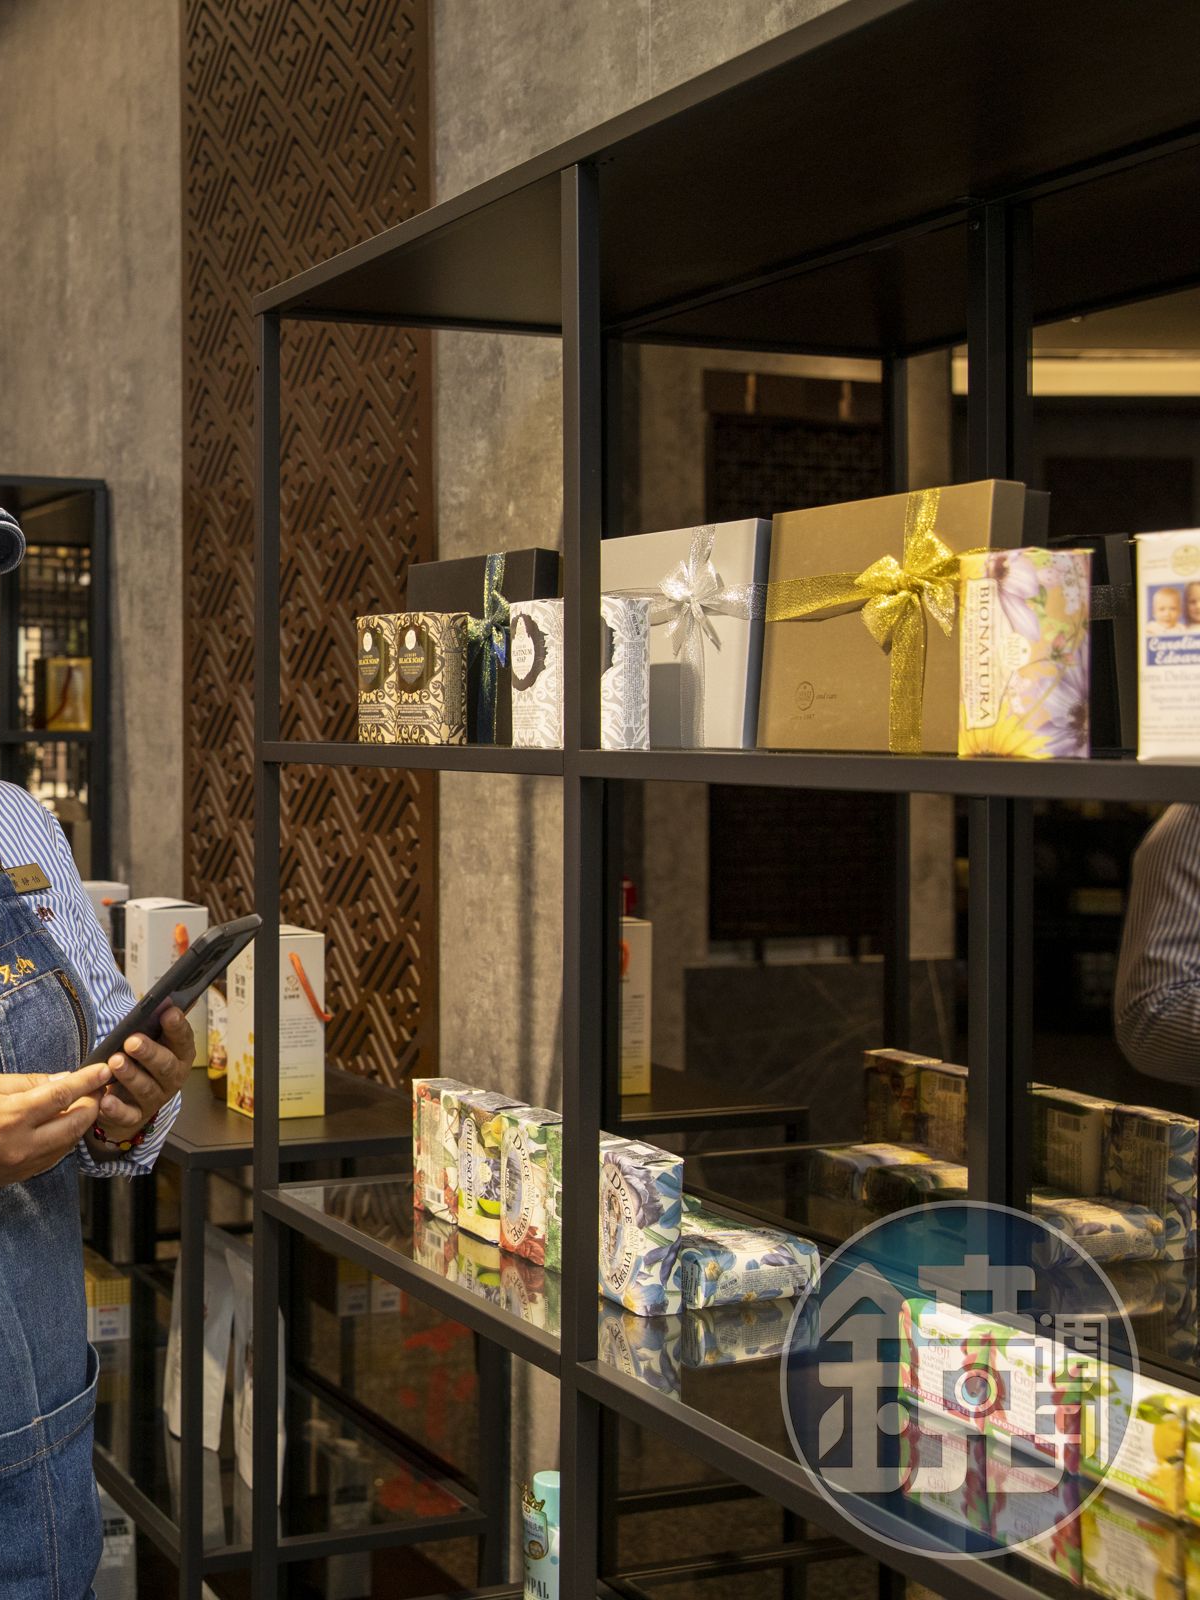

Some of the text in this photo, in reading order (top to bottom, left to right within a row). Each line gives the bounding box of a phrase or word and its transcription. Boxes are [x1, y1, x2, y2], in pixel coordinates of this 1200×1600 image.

[979, 585, 990, 721] BIONATURA
[512, 1133, 532, 1243] DOLCE VIVERE
[609, 1171, 633, 1224] DOLCE
[610, 1251, 633, 1291] VIVERE
